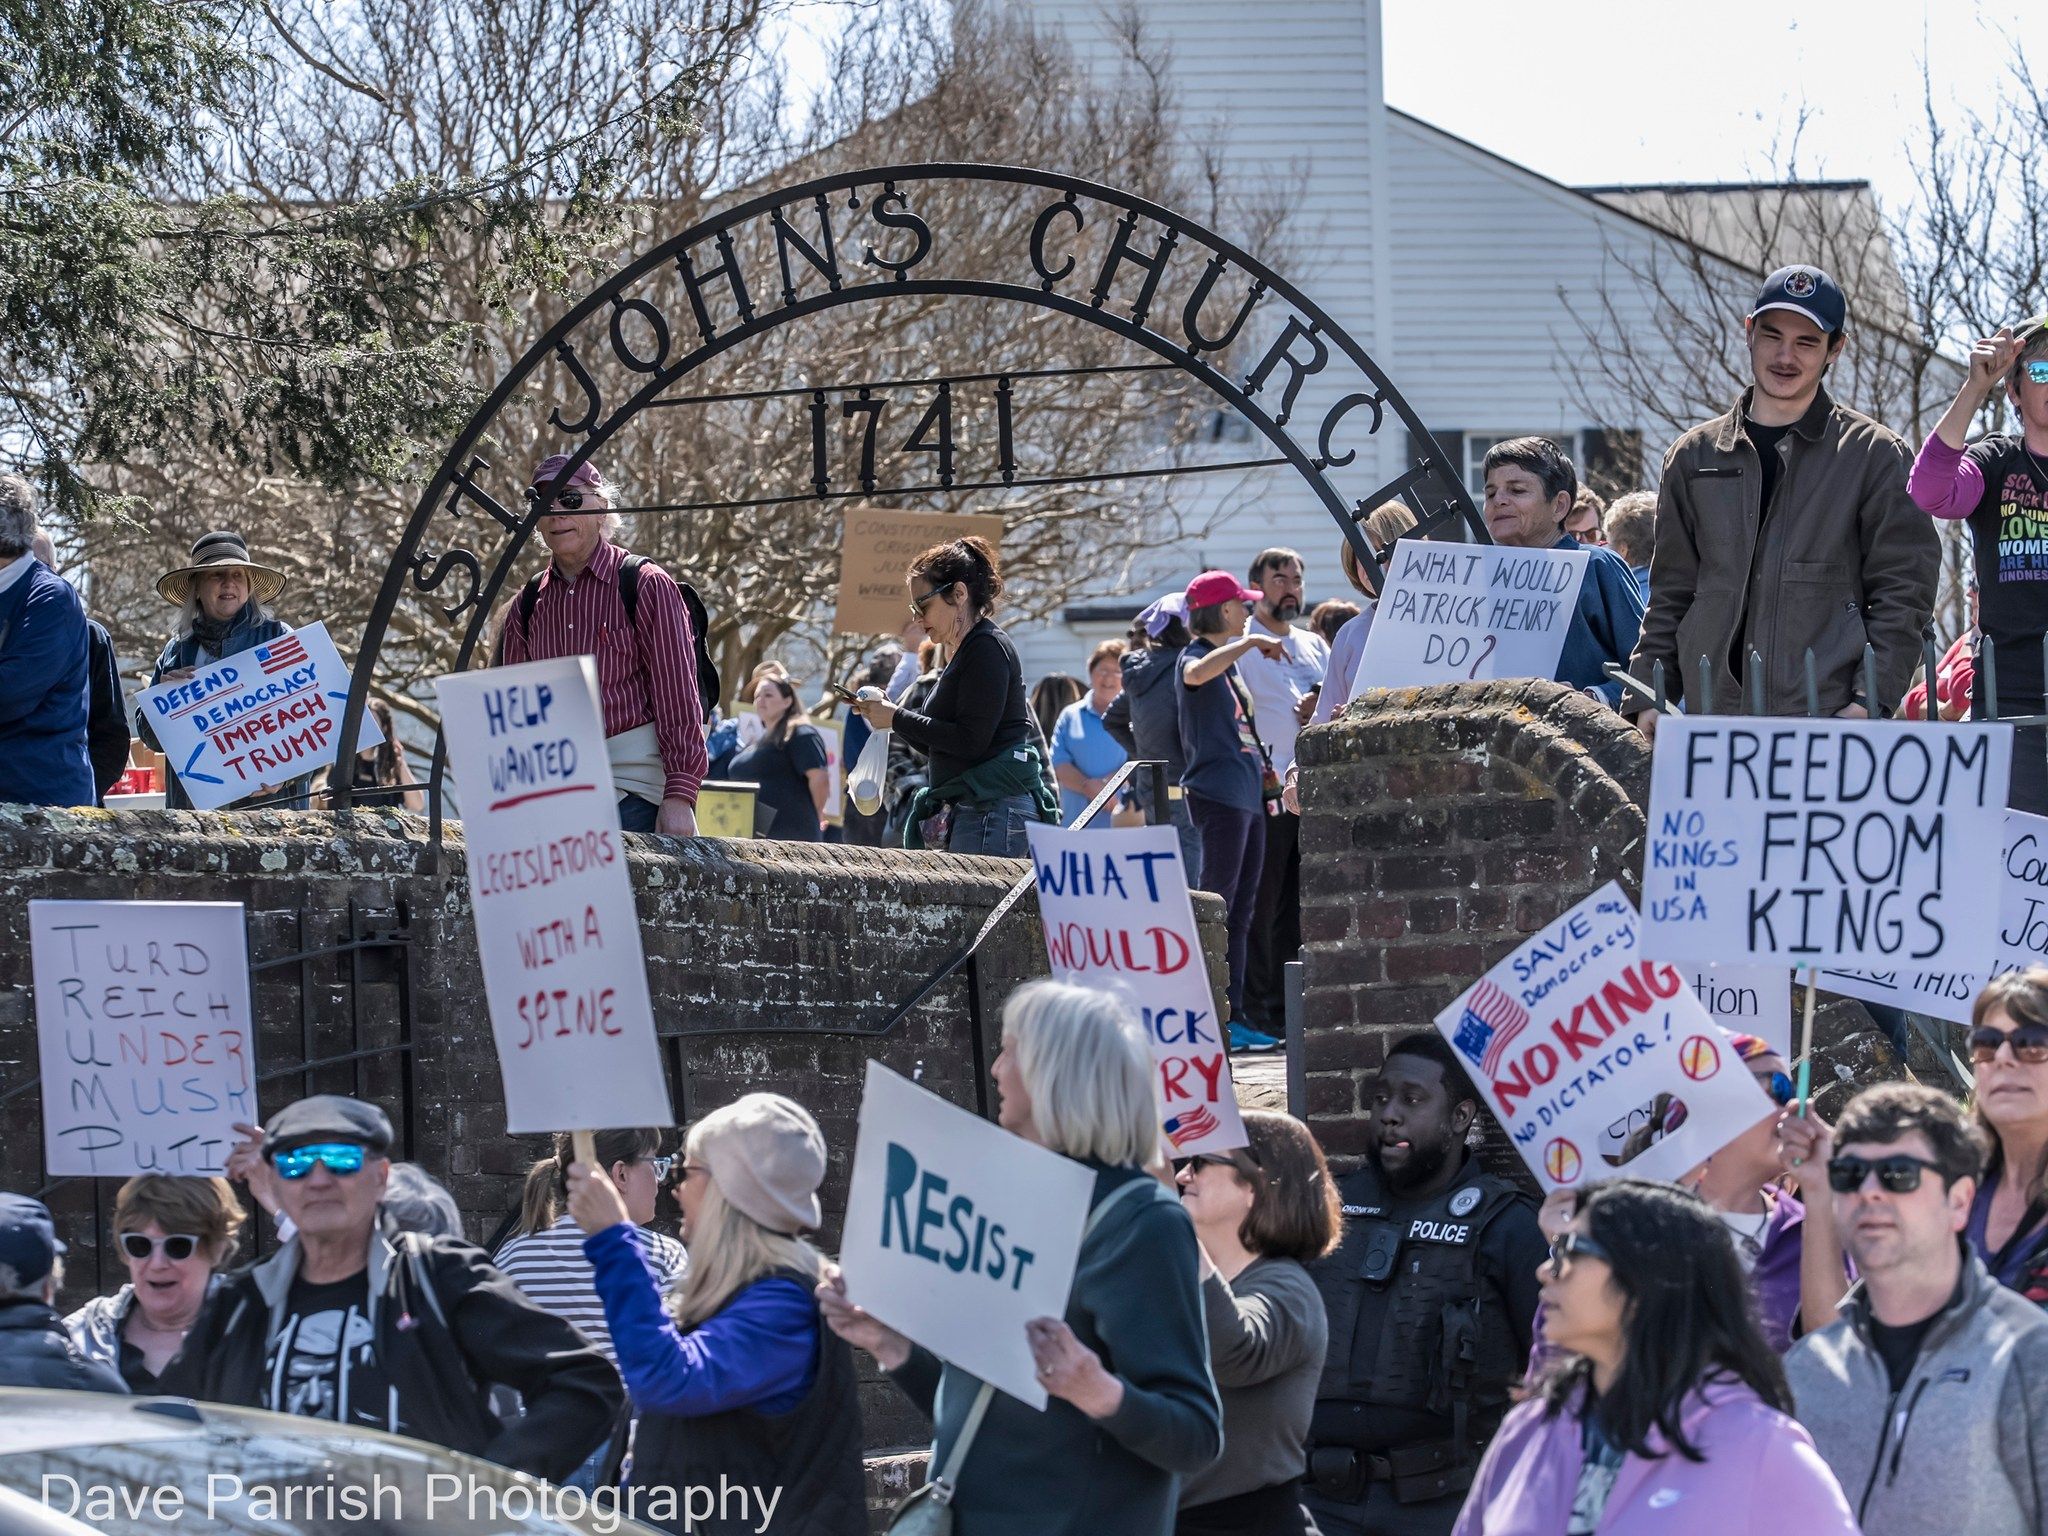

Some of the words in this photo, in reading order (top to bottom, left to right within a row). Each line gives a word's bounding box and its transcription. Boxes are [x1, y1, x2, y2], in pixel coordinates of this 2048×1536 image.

[548, 186, 932, 436] JOHN'S
[1029, 197, 1457, 561] CHURCH
[808, 382, 1015, 488] 1741
[2000, 502, 2017, 517] NO
[2000, 516, 2048, 541] LOVE
[1402, 551, 1481, 585] WHAT
[1491, 557, 1573, 593] WOULD
[2000, 555, 2026, 570] ARE
[1388, 589, 1486, 628] PATRICK
[1488, 598, 1562, 632] HENRY
[1423, 634, 1496, 680] DO?
[152, 667, 239, 715] DEFEND
[192, 662, 316, 732] DEMOCRACY
[484, 683, 553, 737] HELP
[212, 693, 327, 755] IMPEACH
[223, 718, 333, 780] TRUMP
[489, 738, 579, 793] WANTED
[1685, 730, 1988, 807] FREEDOM
[1662, 810, 1705, 838] NO
[1760, 811, 1943, 890] FROM
[477, 830, 616, 896] LEGISLATORS
[1030, 844, 1175, 903] WHAT
[1653, 840, 1739, 868] KINGS
[1674, 870, 1697, 892] IN
[1651, 896, 1707, 922] USA
[1747, 888, 1944, 959] KINGS
[2001, 898, 2048, 955] Jo
[51, 925, 209, 976] TURD
[516, 920, 577, 971] WITH
[583, 904, 604, 950] A
[1043, 922, 1190, 975] WOULD
[1513, 912, 1592, 982] SAVE
[58, 978, 231, 1020] REICH
[518, 987, 622, 1050] SPINE
[1688, 971, 1759, 1016] tion
[66, 1025, 244, 1078] UNDER
[1141, 1007, 1215, 1045] ICK
[1492, 1043, 1560, 1118] NO
[1550, 960, 1680, 1062] KING
[1159, 1053, 1223, 1103] RY
[57, 1126, 236, 1173] PUTI
[1514, 1122, 1537, 1146] NO
[880, 1141, 1035, 1291] RESIST
[1409, 1220, 1469, 1243] POLICE
